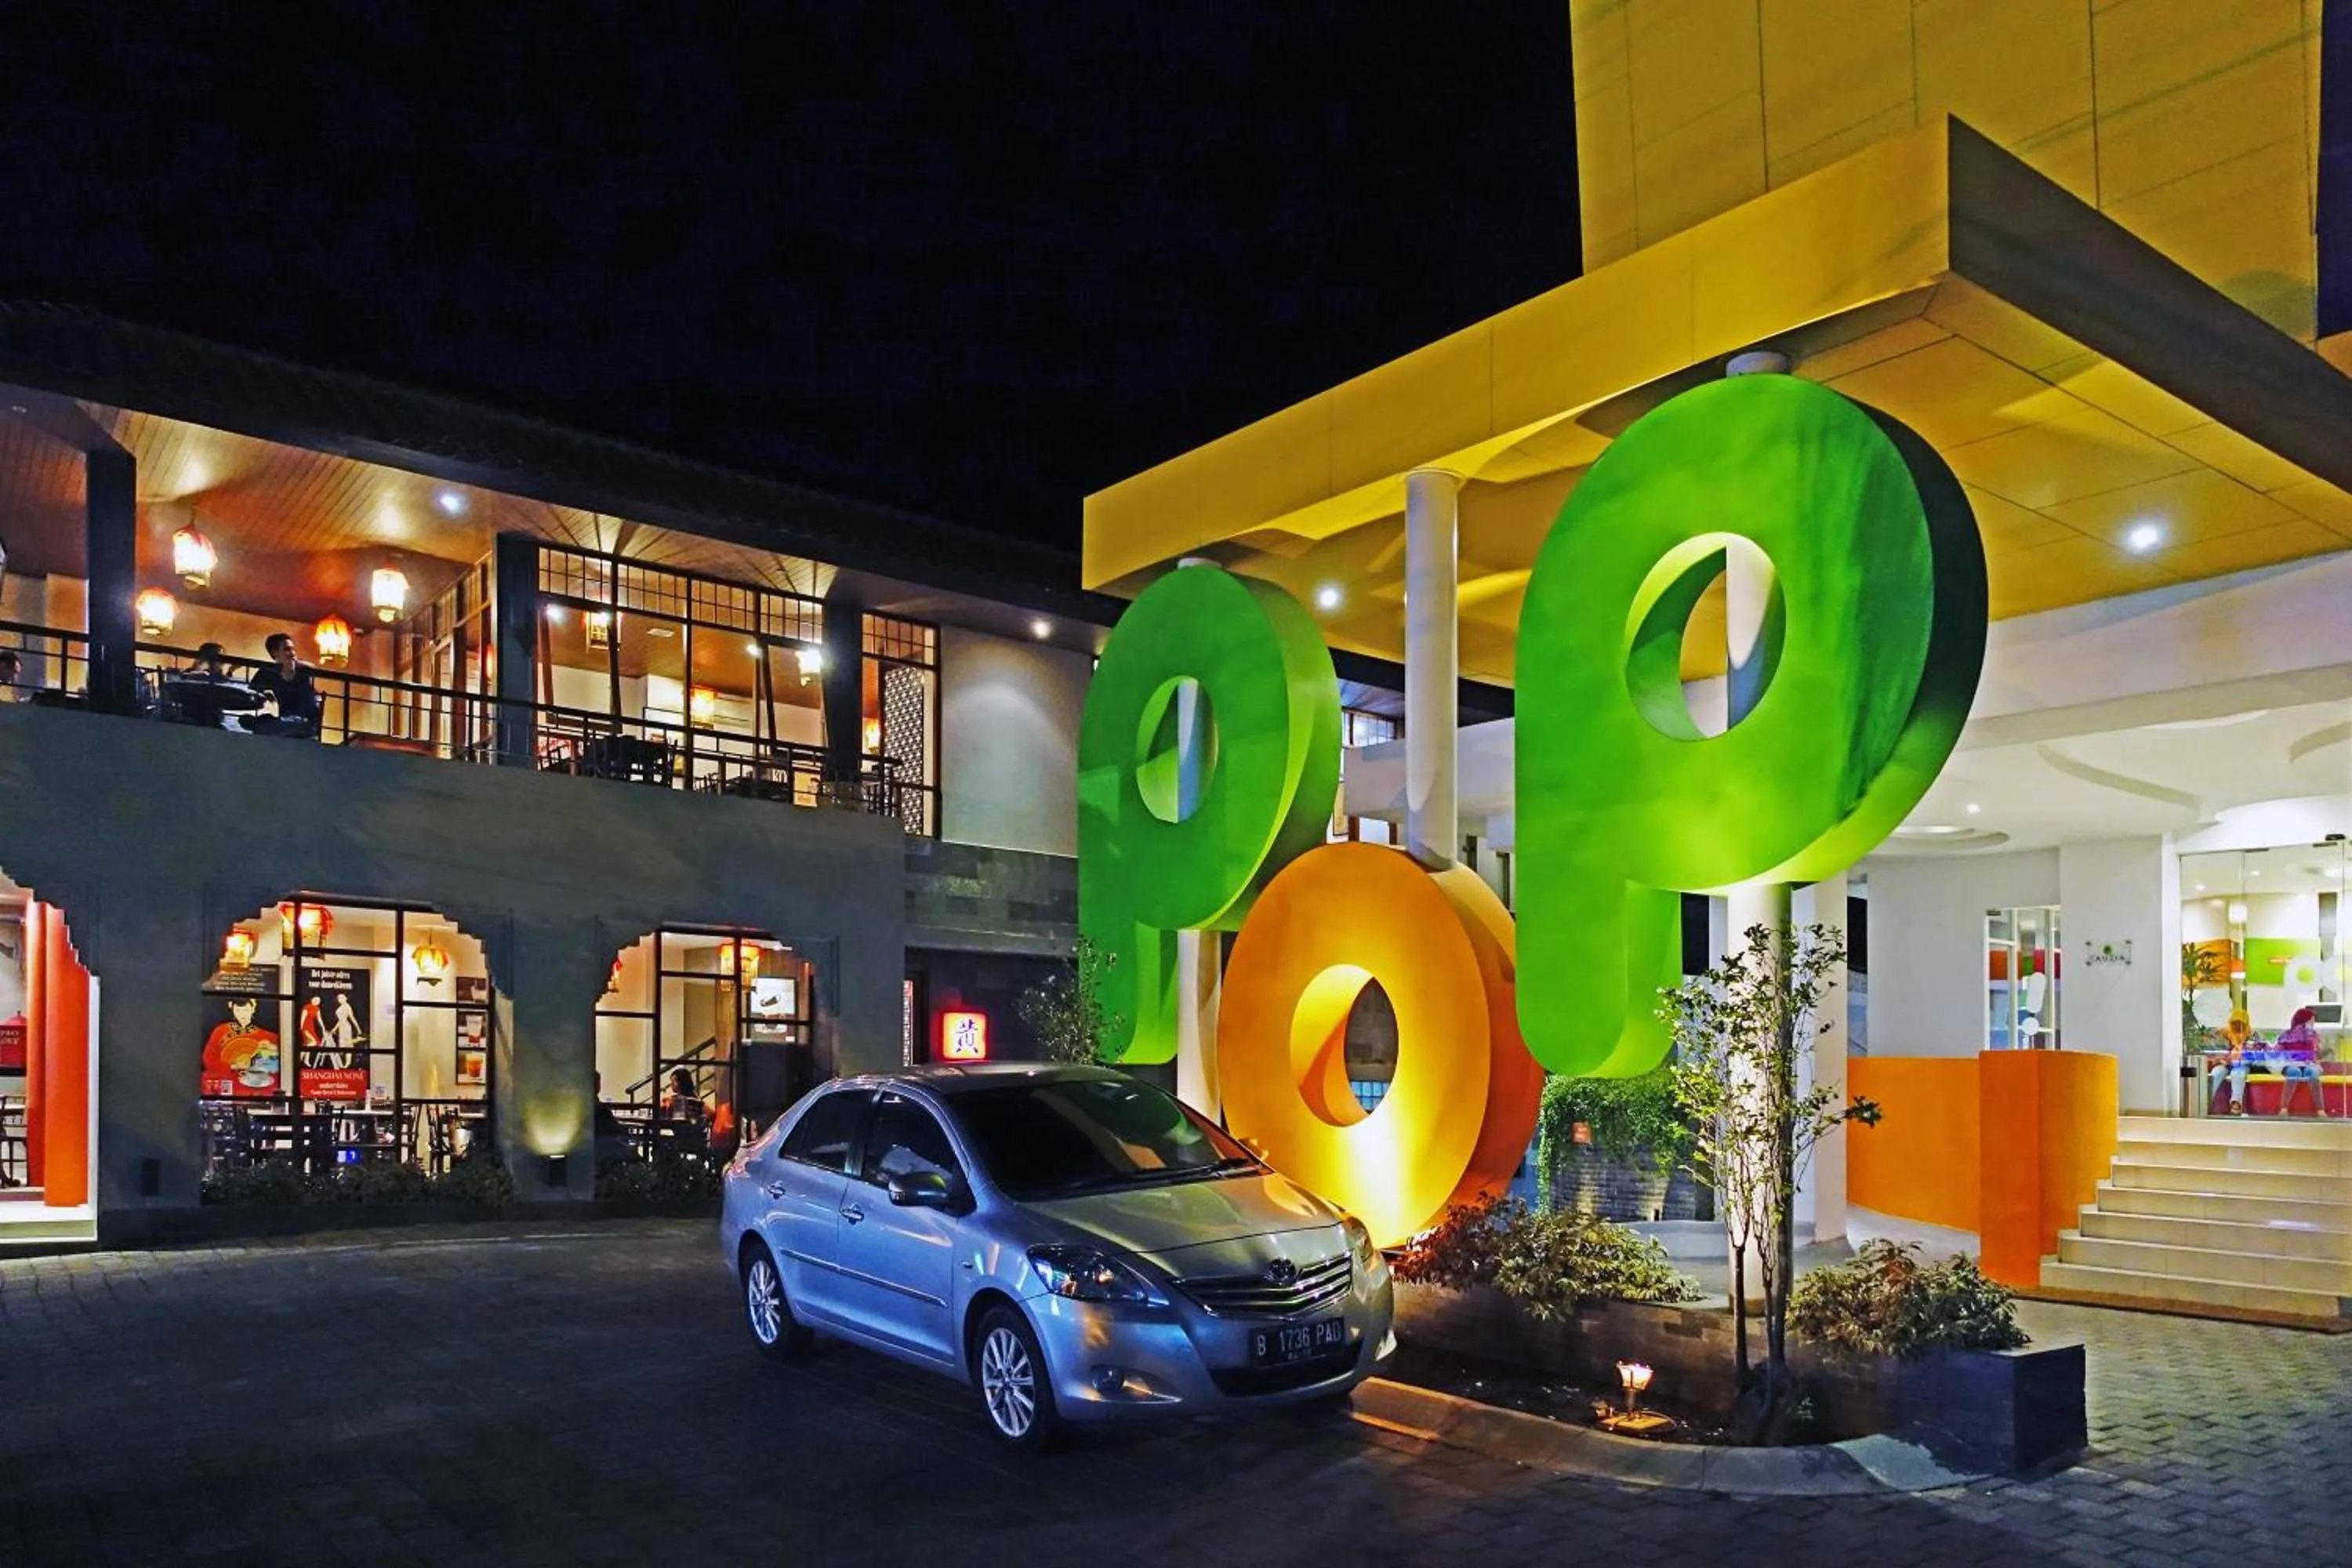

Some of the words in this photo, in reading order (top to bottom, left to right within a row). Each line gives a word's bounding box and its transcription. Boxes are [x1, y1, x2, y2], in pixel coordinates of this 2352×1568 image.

[1257, 1334, 1266, 1356] B
[1279, 1327, 1310, 1352] 1736
[1316, 1320, 1342, 1345] PAD
